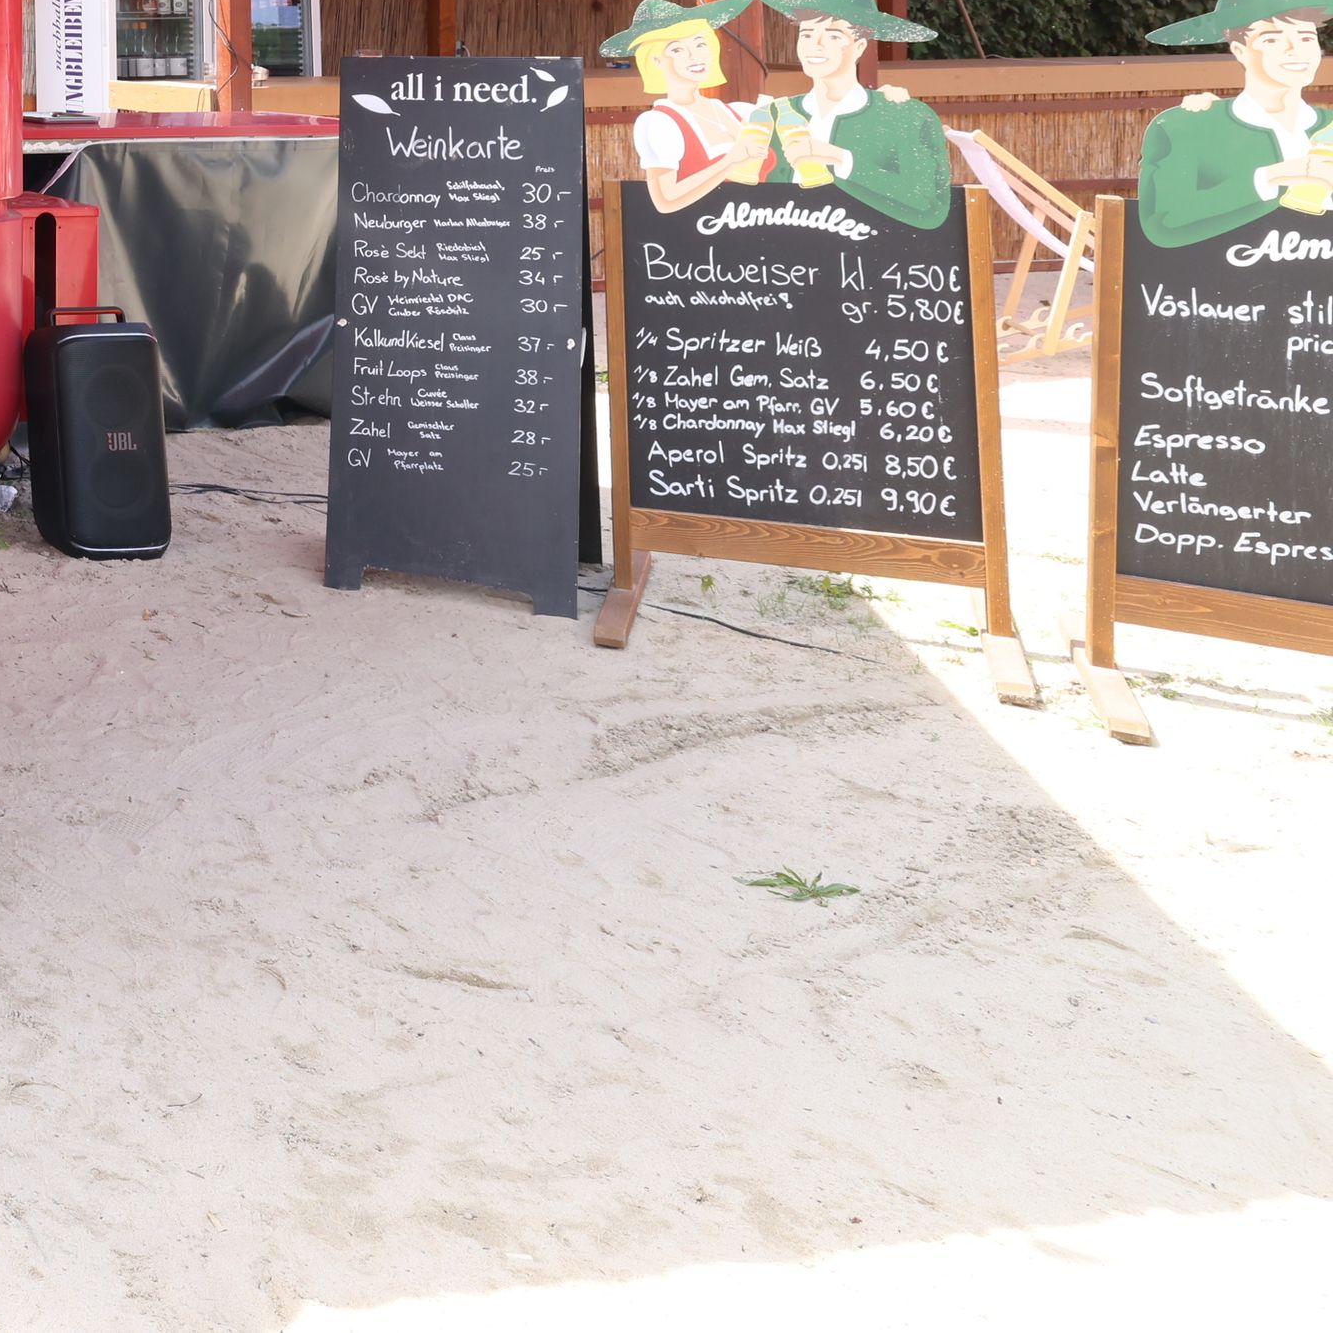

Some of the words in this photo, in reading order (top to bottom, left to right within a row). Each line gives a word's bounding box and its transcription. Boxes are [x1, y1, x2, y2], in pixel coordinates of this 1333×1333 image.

[390, 73, 424, 101] all
[435, 75, 443, 101] i
[453, 75, 537, 103] need.
[385, 125, 523, 161] Weinkarte
[351, 182, 441, 209] Chardonnay
[449, 193, 470, 202] Max
[474, 192, 500, 203] Stiegl
[354, 212, 427, 234] Neuburger
[696, 201, 872, 241] Almdudler
[396, 243, 427, 260] Sekt
[438, 253, 459, 262] Max
[462, 253, 490, 263] Stiegl
[394, 268, 410, 289] by
[411, 267, 464, 287] Nature
[643, 242, 821, 287] Budweiser
[881, 263, 961, 293] 4,50€
[351, 293, 379, 316] GV
[388, 293, 444, 305] Weinviertel
[447, 293, 474, 304] DAC
[388, 306, 421, 316] Gruber
[645, 292, 685, 309] auch
[690, 291, 793, 311] alkoholfrei!
[886, 294, 965, 324] 5,80€
[1141, 283, 1265, 322] Vöslauer
[452, 333, 476, 341] Claus
[666, 327, 766, 359] Spritzer
[776, 331, 822, 358] Weiß
[449, 344, 492, 354] Preisinger
[353, 357, 384, 377] Fruit
[387, 361, 428, 384] Loops
[434, 363, 459, 371] Claus
[435, 371, 479, 381] Preisinger
[663, 366, 719, 387] Zahel
[780, 368, 830, 391] Satz
[351, 385, 402, 408] Strehn
[664, 393, 718, 416] Mayer
[723, 398, 750, 410] am
[810, 398, 839, 416] GV
[1140, 372, 1331, 415] Softgetränke
[350, 418, 391, 439] Zahel
[407, 420, 455, 431] Gemischter
[420, 431, 442, 440] Satz
[663, 414, 766, 438] Chardonnay
[773, 418, 806, 436] Max
[813, 420, 856, 442] Stiegl
[108, 432, 137, 451] JBL
[1134, 424, 1266, 458] Espresso
[347, 448, 371, 467] GV
[387, 449, 419, 459] Mayer
[647, 440, 725, 466] Aperol
[744, 444, 808, 470] Spritz
[394, 460, 444, 475] Pfarrplatz
[1131, 460, 1207, 487] Latte
[649, 470, 715, 499] Sarti
[728, 475, 799, 506] Spritz
[1133, 490, 1312, 524] Verlängerter
[1134, 523, 1224, 555] Dopp.
